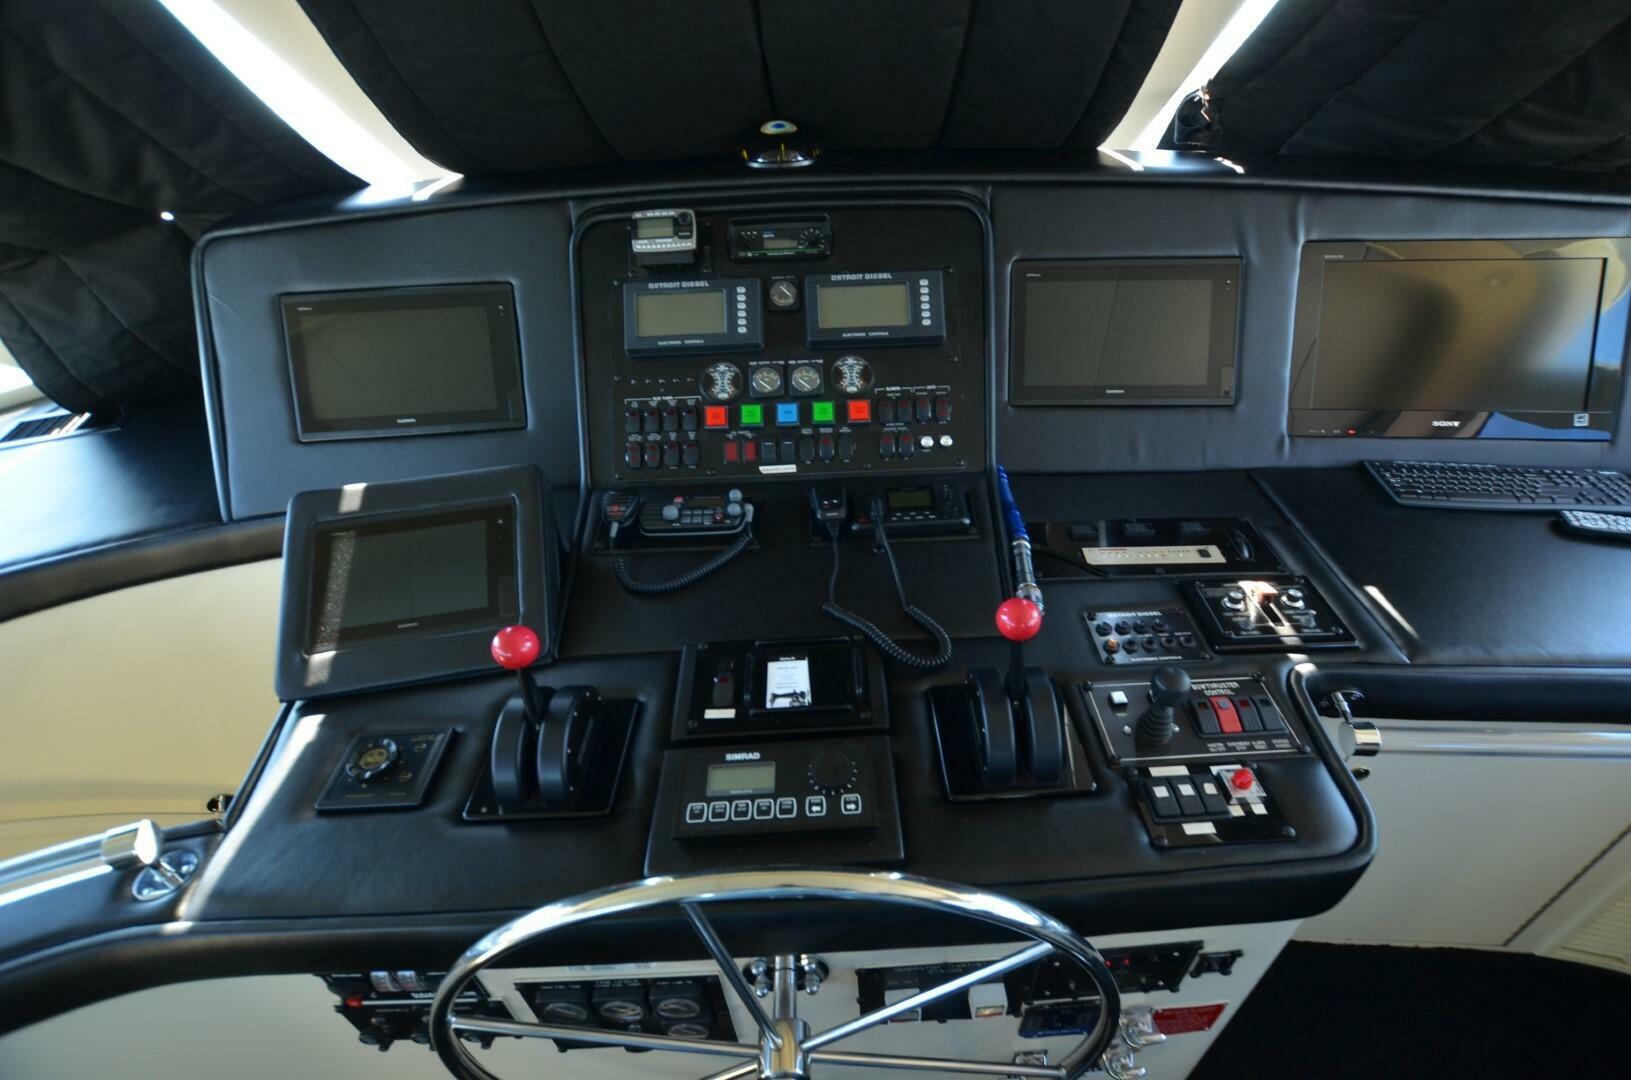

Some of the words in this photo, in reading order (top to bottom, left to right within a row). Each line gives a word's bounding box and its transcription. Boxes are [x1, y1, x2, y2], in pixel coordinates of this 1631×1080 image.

[864, 272, 893, 280] DIESEL
[681, 280, 710, 288] DIESEL
[725, 751, 761, 761] SIMRAD
